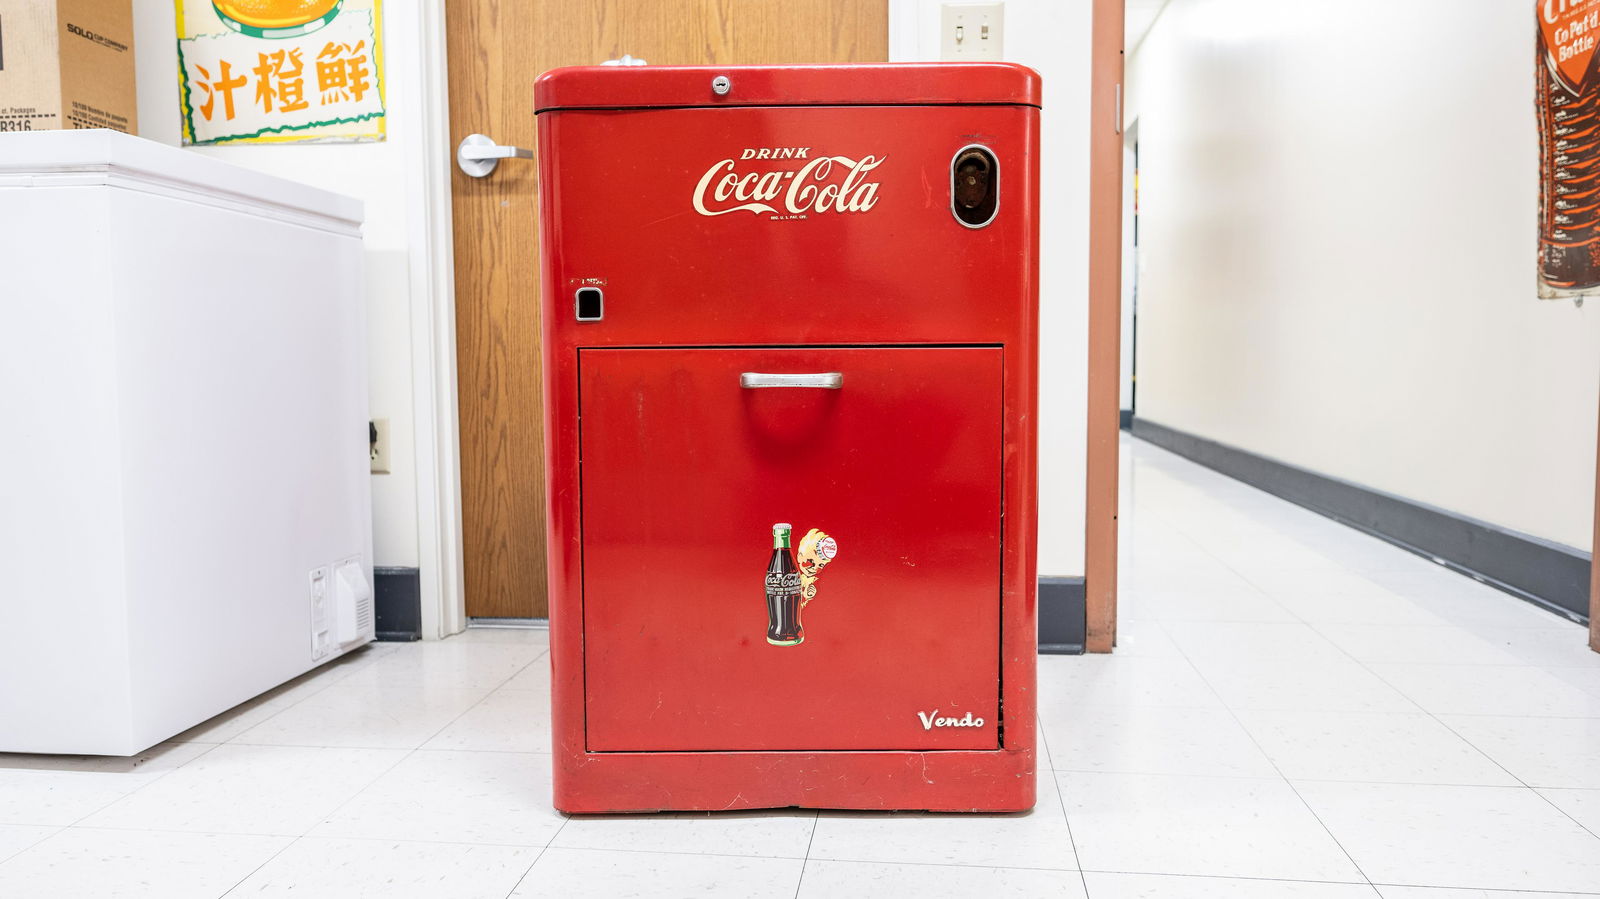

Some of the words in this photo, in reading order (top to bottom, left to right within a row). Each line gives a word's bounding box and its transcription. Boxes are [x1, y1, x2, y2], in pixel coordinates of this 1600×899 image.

[67, 23, 93, 40] SOLO
[1555, 28, 1569, 45] Co
[1559, 36, 1594, 62] Bottle
[10, 107, 36, 116] Packages
[740, 147, 811, 160] DRINK
[692, 154, 888, 216] Coca-Cola
[765, 571, 801, 588] Coca-Cola
[917, 709, 984, 730] Vendo
